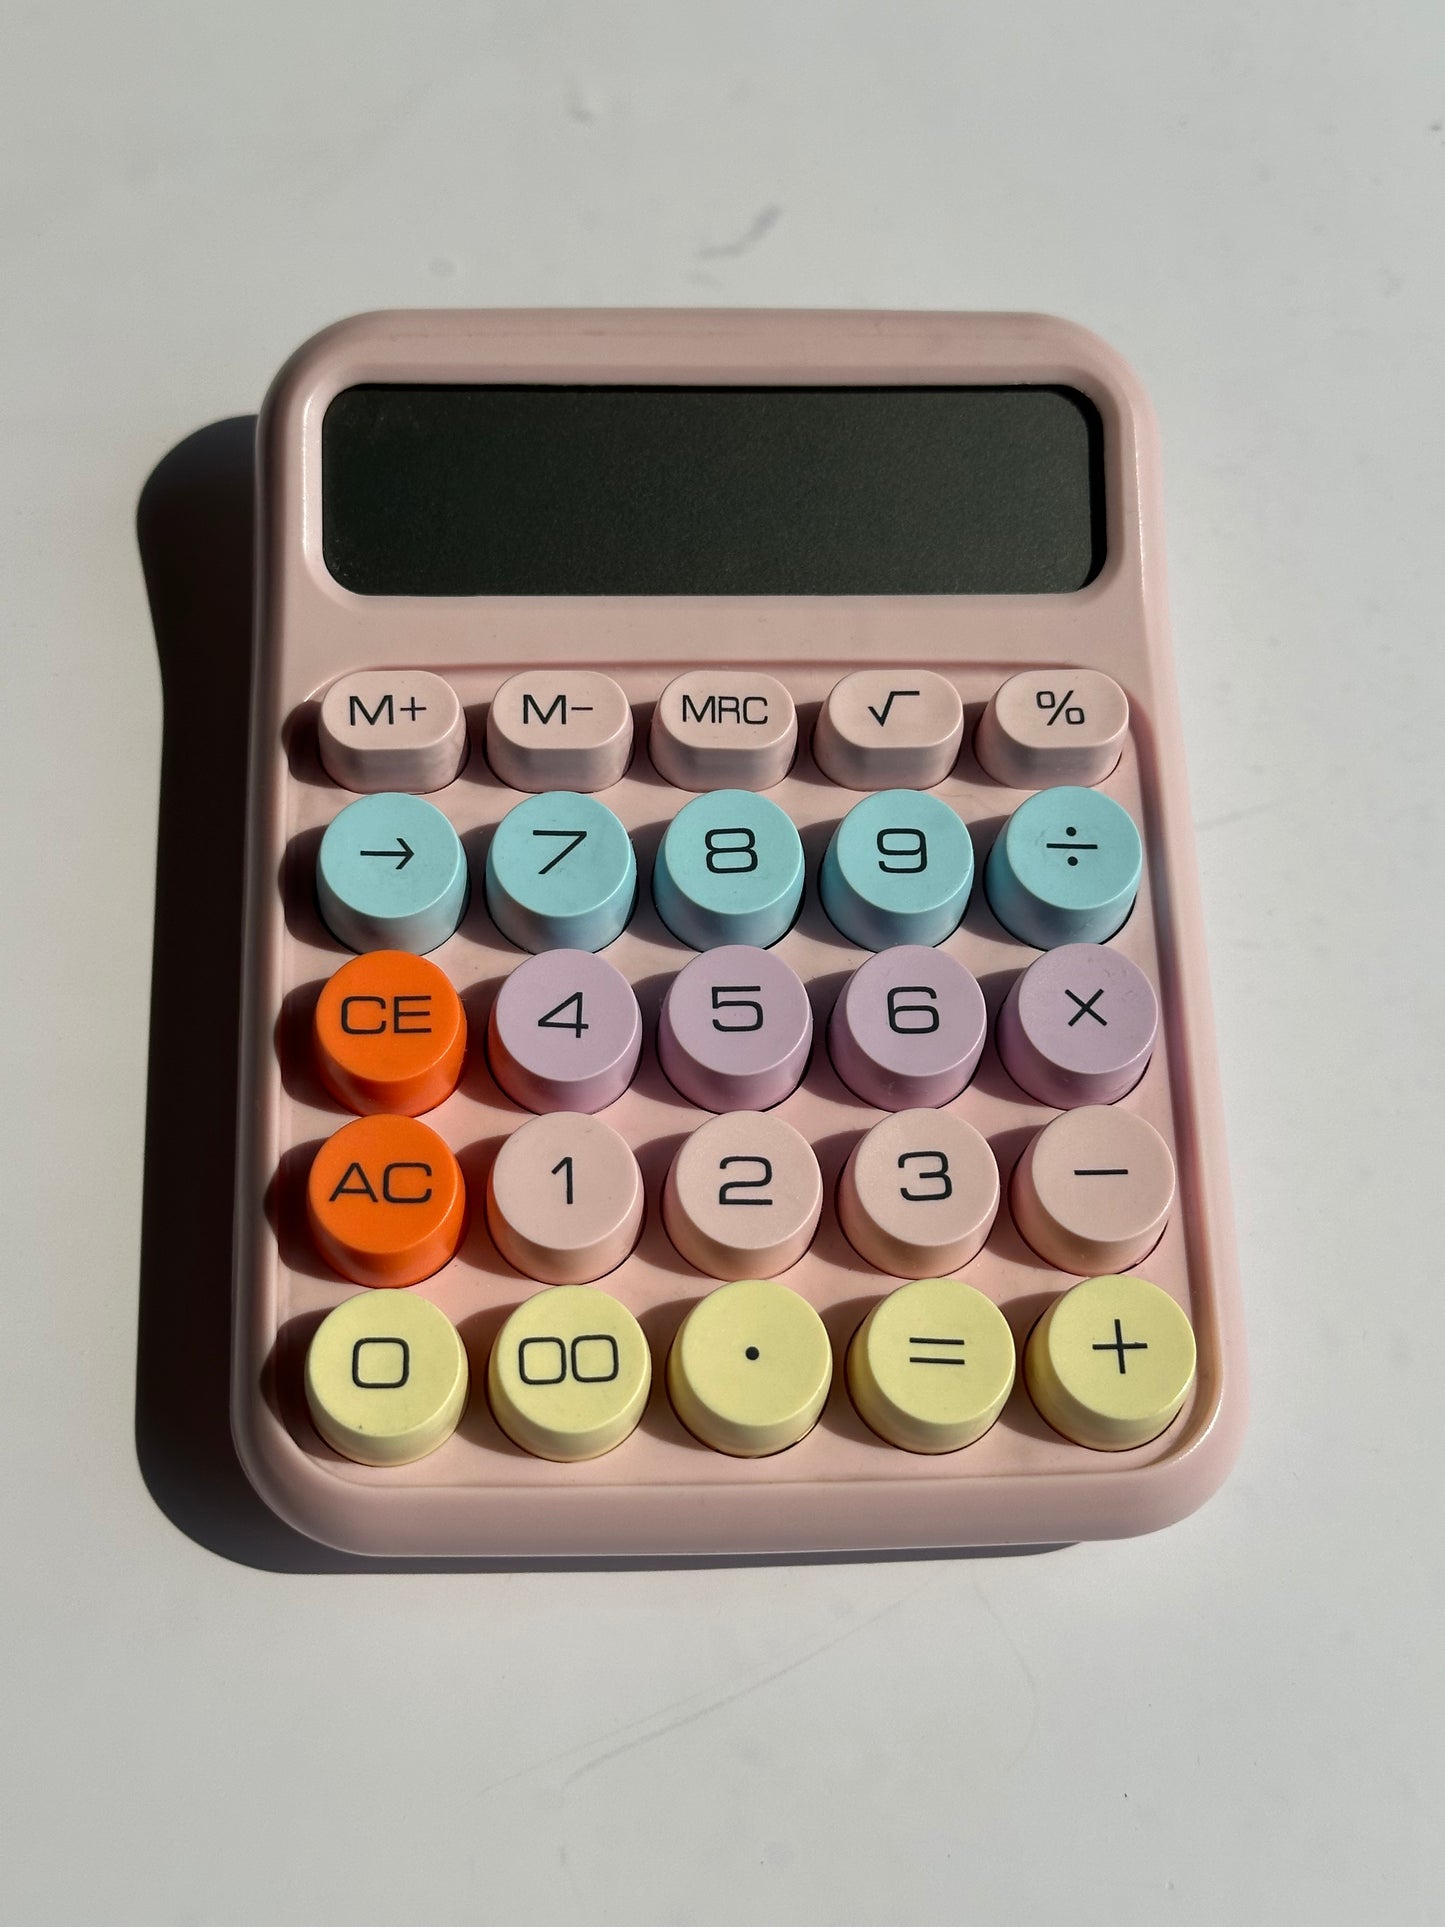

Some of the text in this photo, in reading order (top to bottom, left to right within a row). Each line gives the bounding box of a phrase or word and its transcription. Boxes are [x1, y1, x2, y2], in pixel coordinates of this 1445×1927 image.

[349, 694, 427, 726] M+
[523, 694, 594, 725] M-
[682, 694, 769, 725] MRC
[1036, 690, 1085, 726] %
[532, 829, 588, 875] 7
[704, 827, 759, 874] 8
[876, 828, 928, 874] 9
[340, 995, 432, 1035] CE
[537, 991, 589, 1039] 4
[711, 985, 764, 1033] 5
[887, 986, 940, 1035] 6
[328, 1162, 432, 1204] AC
[551, 1156, 574, 1205] 1
[718, 1155, 773, 1206] 2
[897, 1150, 953, 1202] 3
[351, 1337, 410, 1389] 0
[518, 1334, 619, 1386] 00
[1092, 1318, 1148, 1375] +
